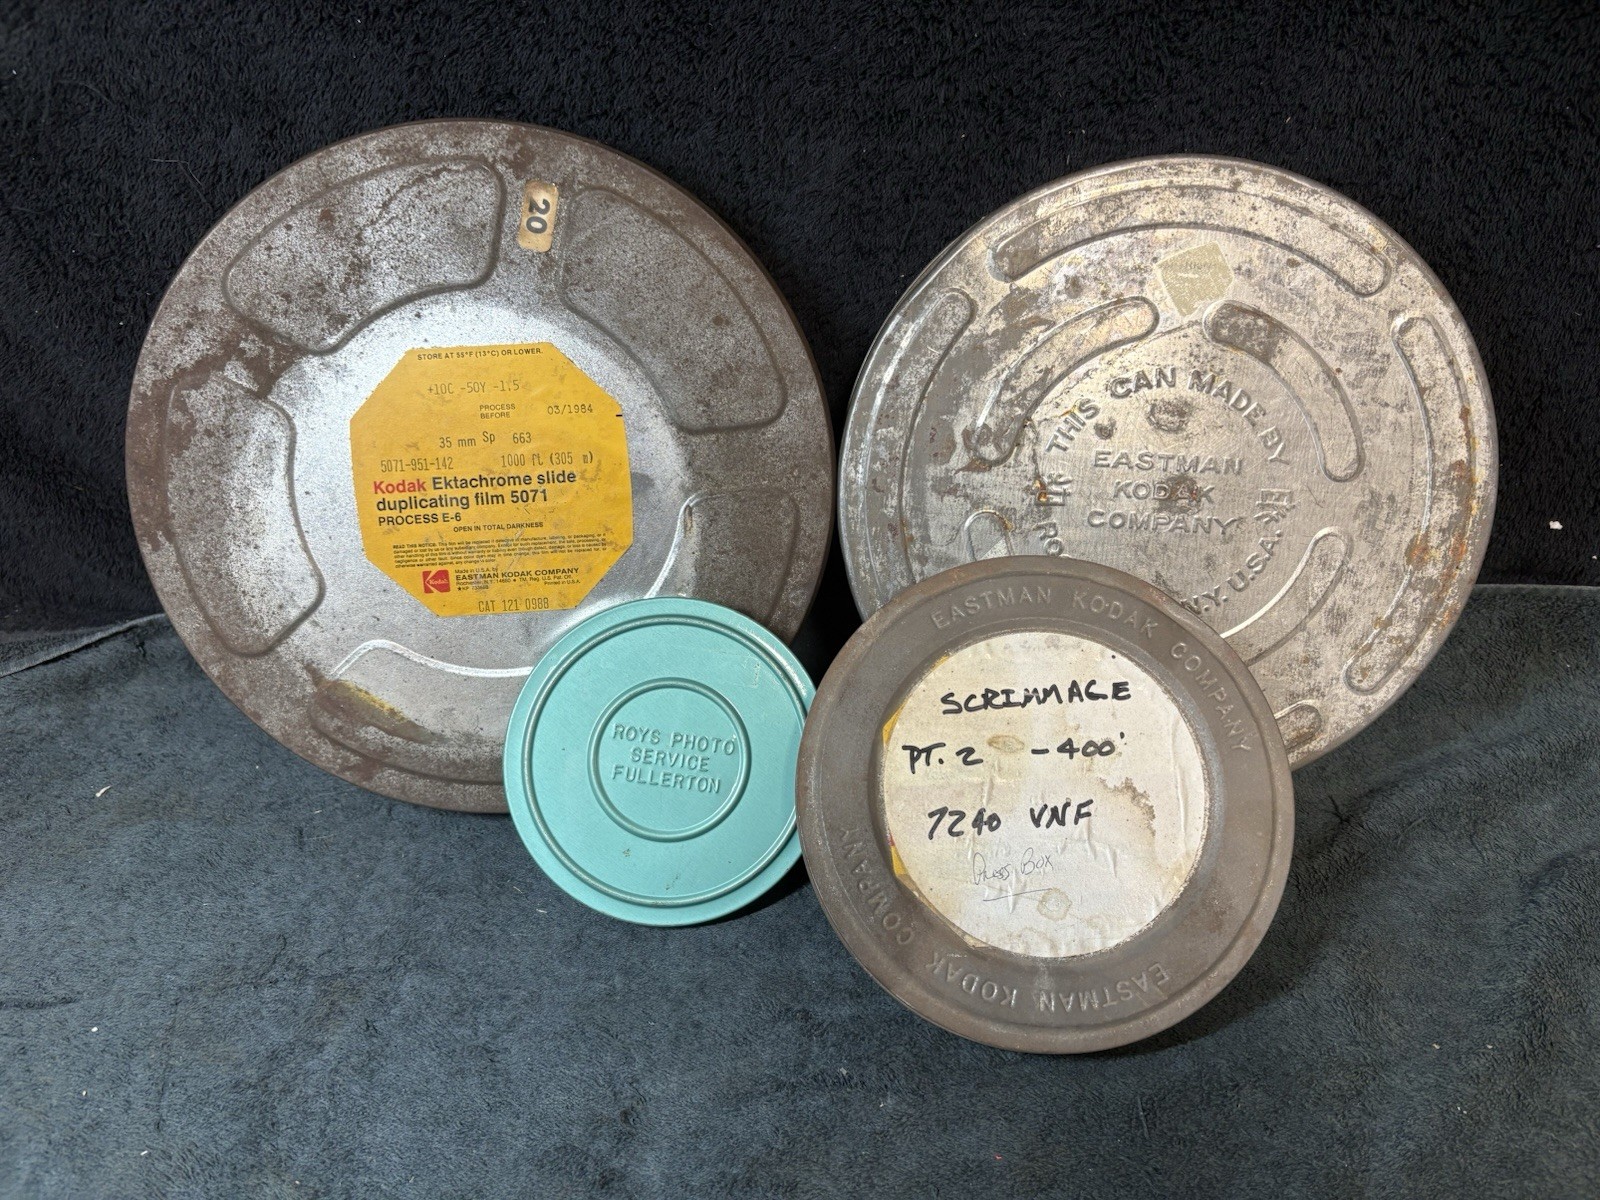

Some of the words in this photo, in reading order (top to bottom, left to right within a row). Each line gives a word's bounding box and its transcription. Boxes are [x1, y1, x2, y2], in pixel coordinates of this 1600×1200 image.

[526, 197, 550, 234] 20
[547, 404, 593, 415] 03/1984
[1045, 398, 1100, 453] THIS
[1110, 367, 1177, 399] CAN
[1188, 370, 1267, 427] MADE
[1258, 426, 1290, 465] BY
[439, 437, 452, 449] 35
[458, 437, 476, 448] mm
[482, 430, 495, 444] Sp
[512, 432, 532, 444] 663
[380, 457, 454, 473] 5071-951-142
[501, 454, 526, 468] 1000
[532, 453, 543, 466] ft
[1093, 450, 1242, 475] EASTMAN
[373, 478, 427, 494] Kodak
[432, 472, 532, 490] Ektachrome
[537, 470, 577, 485] slide
[1113, 479, 1216, 504] KODAK
[376, 494, 470, 513] duplicating
[474, 491, 505, 506] film
[510, 488, 548, 503] 5071
[378, 514, 438, 526] PROCESS
[442, 512, 462, 523] E-6
[507, 521, 544, 529] DARKNESS
[1087, 510, 1244, 536] COMPANY
[478, 601, 495, 612] CAT
[503, 599, 520, 611] 121
[526, 598, 549, 610] 0988
[930, 586, 1051, 630] EASTMAN
[1072, 590, 1160, 640] KODAK
[1169, 642, 1251, 752] COMPANY
[613, 723, 661, 745] ROYS
[670, 731, 735, 755] PHOTO
[630, 747, 710, 773] SERVICE
[955, 747, 984, 766] 2
[612, 765, 721, 794] FULLERTON
[1029, 799, 1094, 829] VNF
[842, 827, 914, 945] COMPANY
[925, 951, 1018, 1010] KODAK
[1032, 962, 1172, 1013] EASTMAN
